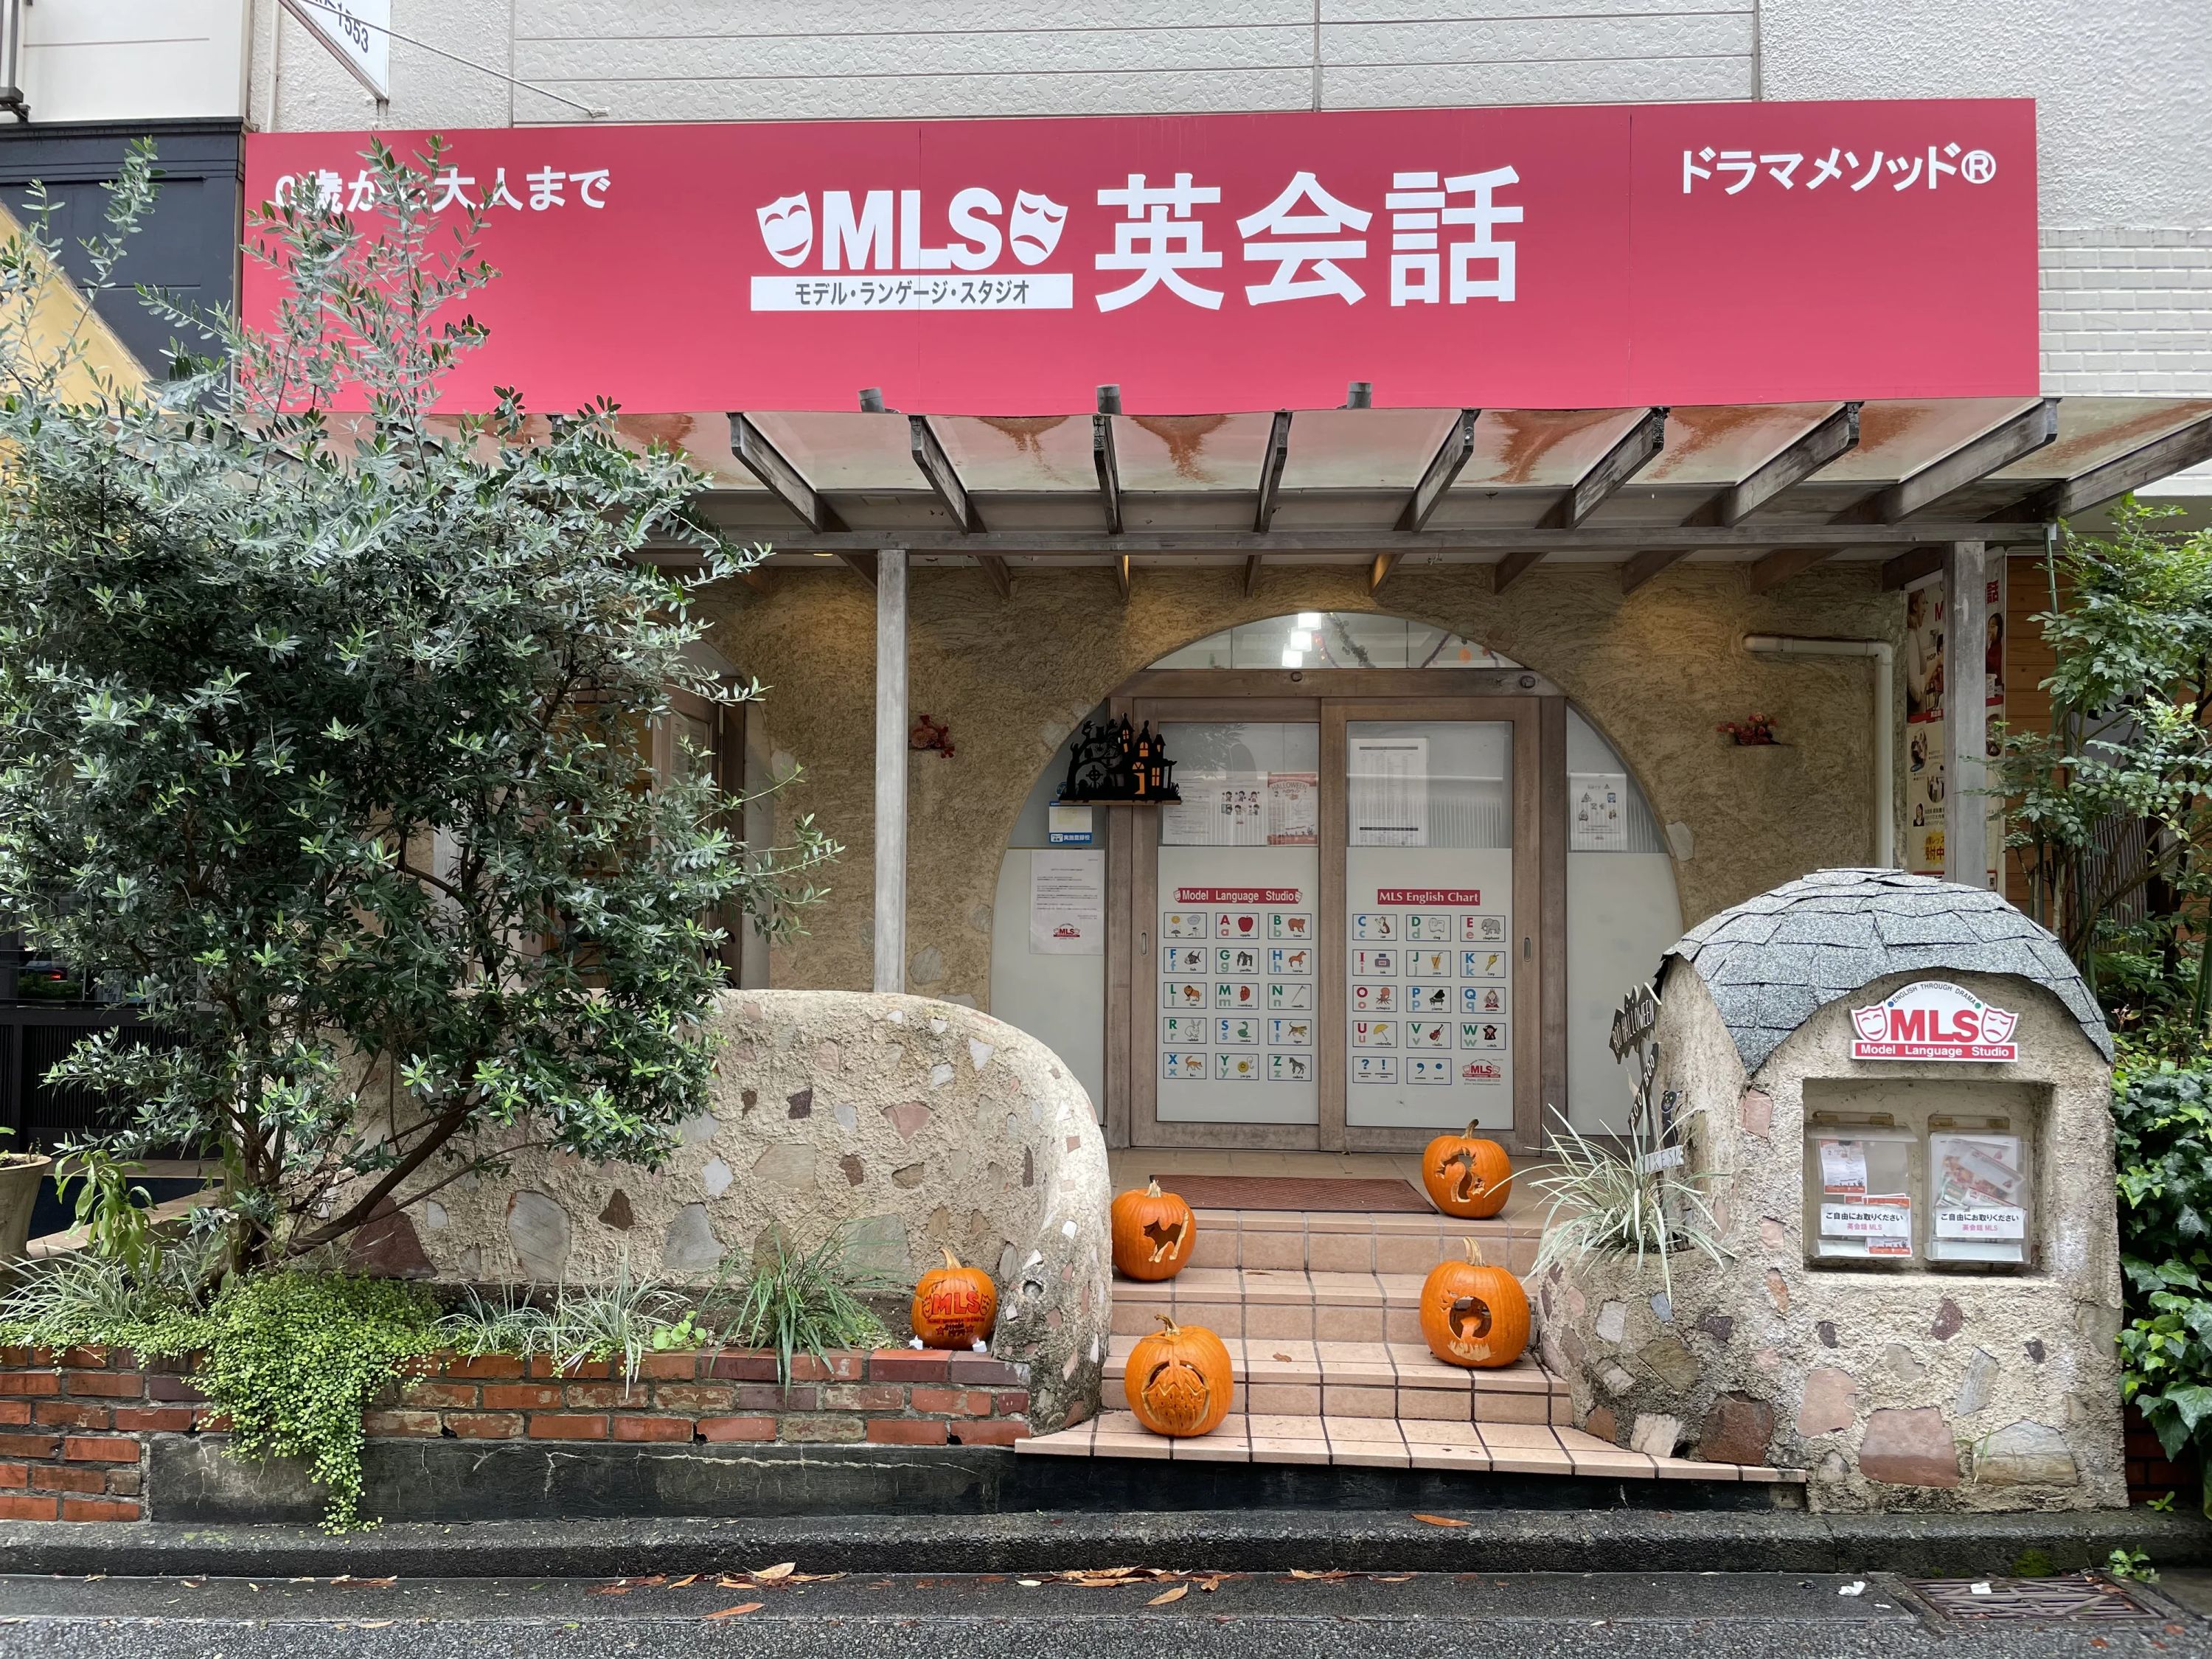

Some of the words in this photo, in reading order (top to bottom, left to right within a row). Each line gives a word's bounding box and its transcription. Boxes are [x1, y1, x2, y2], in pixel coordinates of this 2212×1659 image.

[822, 187, 1003, 271] MLS
[1095, 165, 1523, 313] 英会話
[795, 279, 1029, 305] モデル・ランゲージ・スタジオ
[1270, 782, 1308, 791] HALLOWEEN
[1182, 890, 1208, 900] Model
[1216, 891, 1259, 902] Language
[1266, 891, 1294, 901] Studio
[1380, 891, 1402, 901] MLS
[1406, 891, 1444, 904] English
[1447, 892, 1478, 902] Chart
[1220, 915, 1230, 925] A
[1274, 915, 1281, 925] B
[1358, 917, 1366, 926] C
[1412, 917, 1421, 926] D
[1467, 918, 1473, 928] E
[1273, 926, 1281, 937] b
[1412, 928, 1420, 939] d
[1170, 949, 1176, 959] F
[1220, 950, 1230, 960] G
[1273, 950, 1282, 960] H
[1413, 952, 1419, 962] J
[1466, 953, 1475, 963] K
[1171, 960, 1176, 971] f
[1221, 962, 1228, 972] g
[1273, 961, 1281, 972] h
[1466, 965, 1474, 975] k
[1171, 984, 1176, 994] L
[1219, 985, 1231, 995] M
[1273, 986, 1282, 995] N
[1357, 987, 1368, 998] O
[1412, 988, 1420, 998] P
[1464, 989, 1476, 999] Q
[1892, 986, 1918, 1004] ENGLISH
[1920, 983, 1952, 992] THROUGH
[1955, 988, 1976, 1004] DRAMA
[1274, 999, 1281, 1007] n
[1412, 1001, 1420, 1011] p
[1466, 1002, 1474, 1012] q
[1169, 1020, 1177, 1029] R
[1222, 1020, 1228, 1030] S
[1274, 1020, 1281, 1031] T
[1358, 1023, 1367, 1033] U
[1411, 1023, 1421, 1034] V
[1891, 1009, 1979, 1043] MLS
[1463, 1025, 1478, 1035] W
[1276, 1033, 1280, 1043] t
[1861, 1044, 1896, 1054] Model
[1905, 1046, 1963, 1057] Language
[1972, 1046, 2009, 1057] Studio
[1168, 1054, 1178, 1064] X
[1220, 1056, 1229, 1065] Y
[1273, 1057, 1281, 1066] Z
[1221, 1068, 1229, 1078] y
[1470, 1065, 1492, 1074] MLS
[1644, 1054, 1655, 1088] BOO
[1826, 1212, 1903, 1221] ご自由にお取りください
[1941, 1214, 2019, 1222] ご自由にお取りください
[933, 1291, 980, 1315] MLS
